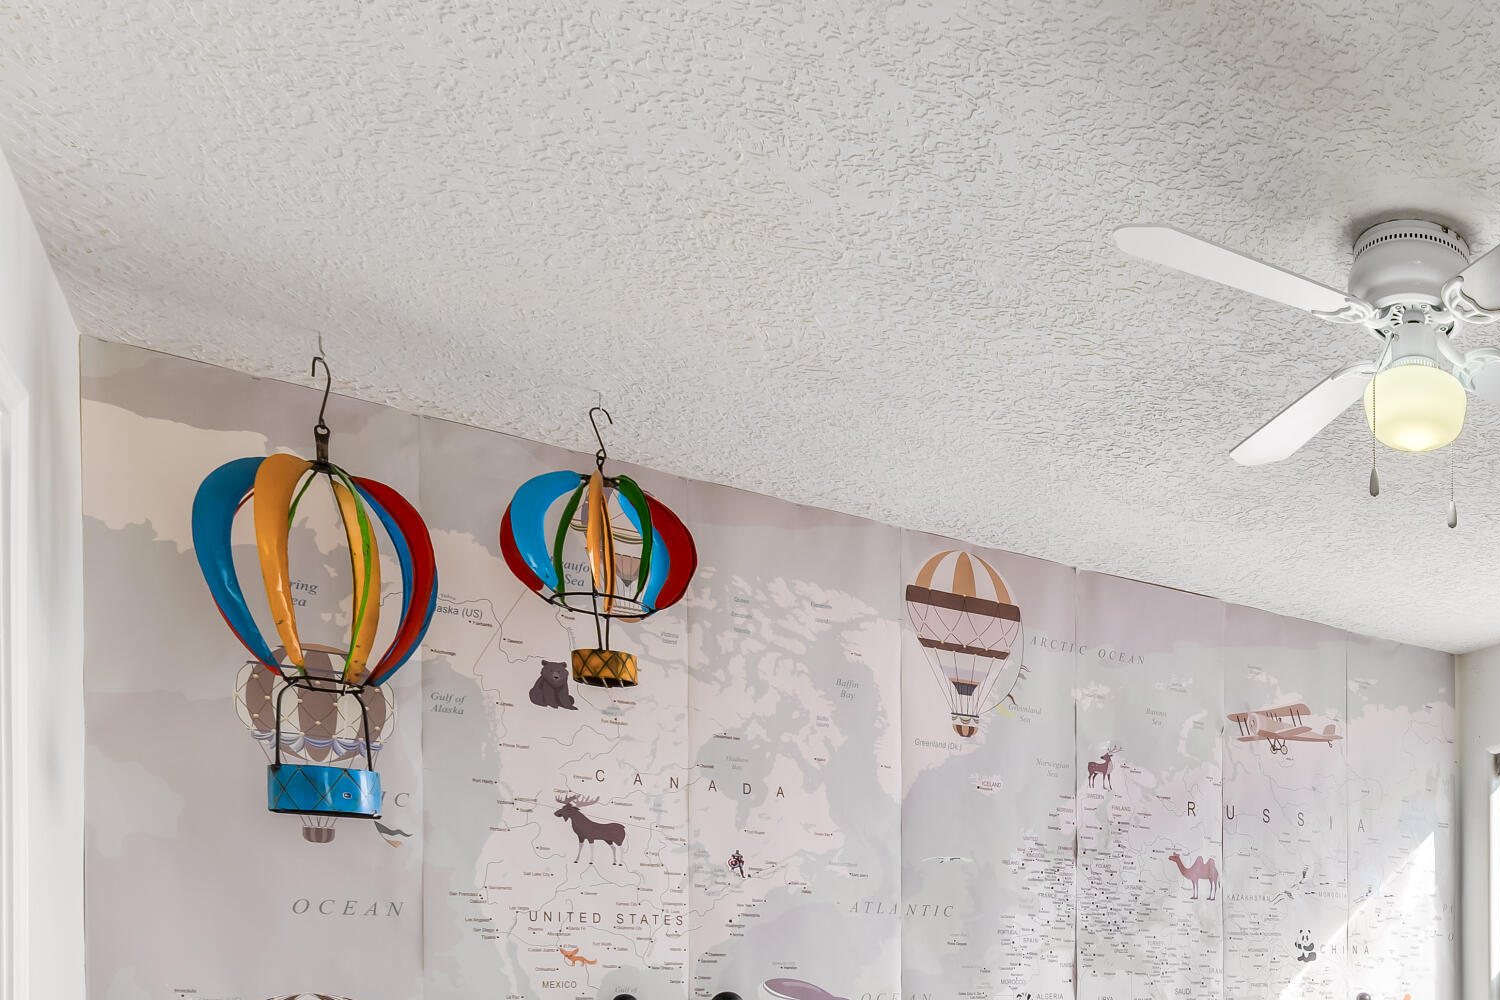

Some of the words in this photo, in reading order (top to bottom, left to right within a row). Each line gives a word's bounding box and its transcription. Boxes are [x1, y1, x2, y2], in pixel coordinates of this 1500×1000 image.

[564, 574, 585, 587] Sea
[289, 580, 317, 594] ring
[292, 598, 306, 607] ea
[462, 607, 483, 619] (US)
[1029, 636, 1088, 656] ARCTIC
[1097, 649, 1145, 665] OCEAN
[835, 678, 860, 689] Baffin
[430, 692, 452, 703] Gulf
[455, 695, 466, 704] of
[840, 690, 856, 700] Bay
[431, 704, 464, 715] Alaska
[1008, 703, 1042, 716] Greenland
[1019, 716, 1031, 724] Sea
[914, 738, 947, 750] Greenland
[1036, 758, 1070, 768] Norwegian
[595, 769, 785, 798] CANADA
[1187, 801, 1365, 832] RUSSIA
[292, 898, 404, 917] OCEAN
[849, 901, 954, 918] ATLANTIC
[529, 911, 601, 923] UNITED
[616, 913, 683, 926] STATES
[1319, 944, 1370, 955] CHINA
